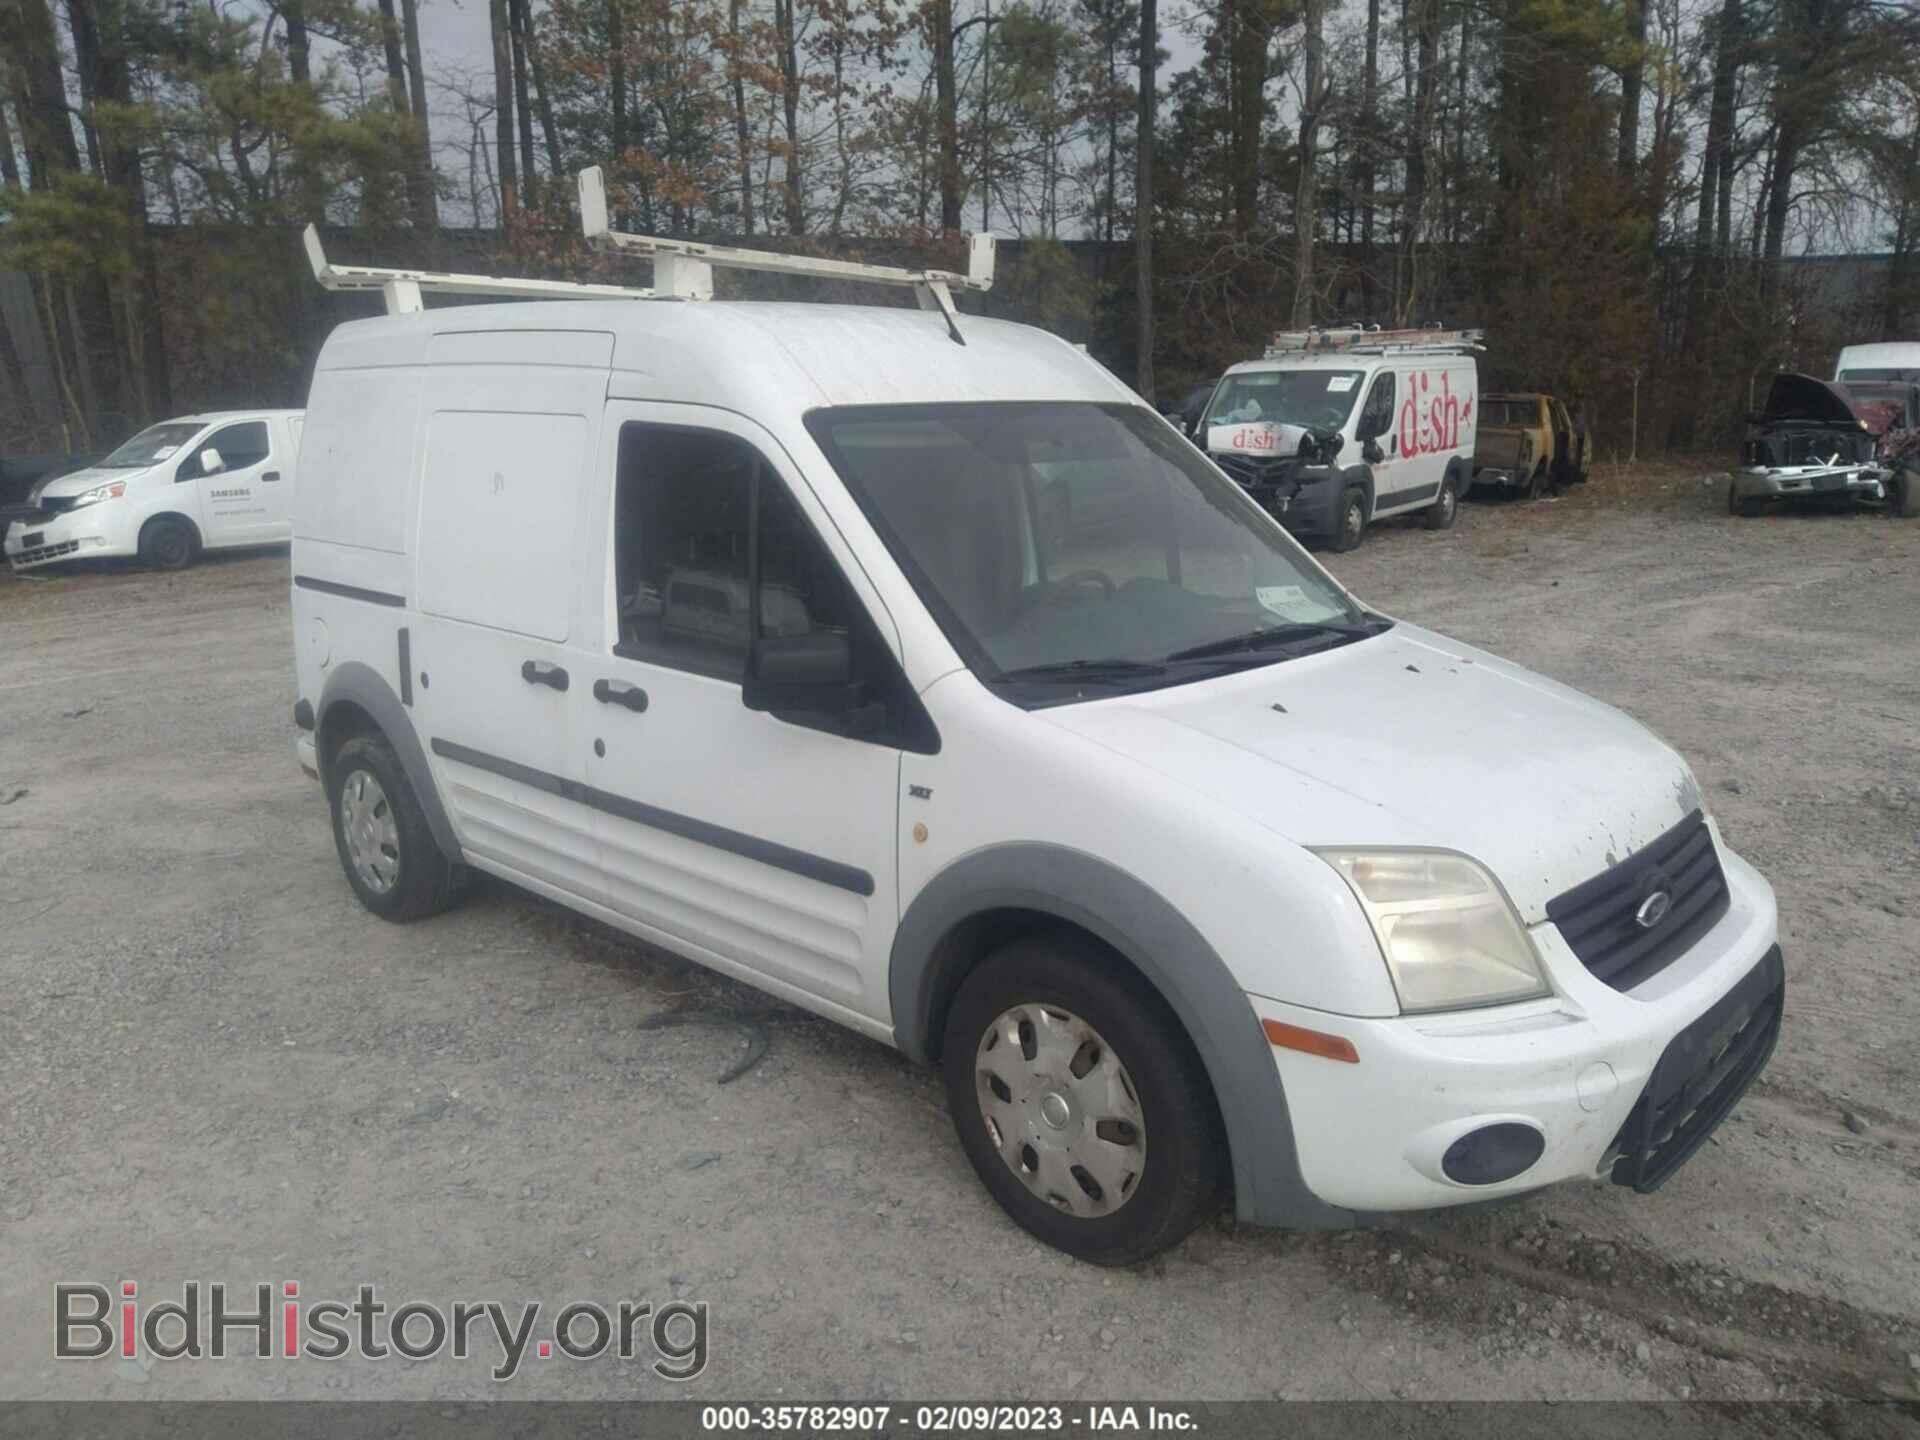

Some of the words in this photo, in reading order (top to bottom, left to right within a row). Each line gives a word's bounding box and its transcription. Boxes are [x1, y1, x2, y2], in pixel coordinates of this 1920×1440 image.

[1400, 370, 1458, 459] dish
[1232, 429, 1273, 449] dish
[210, 488, 251, 498] SAMSUNG
